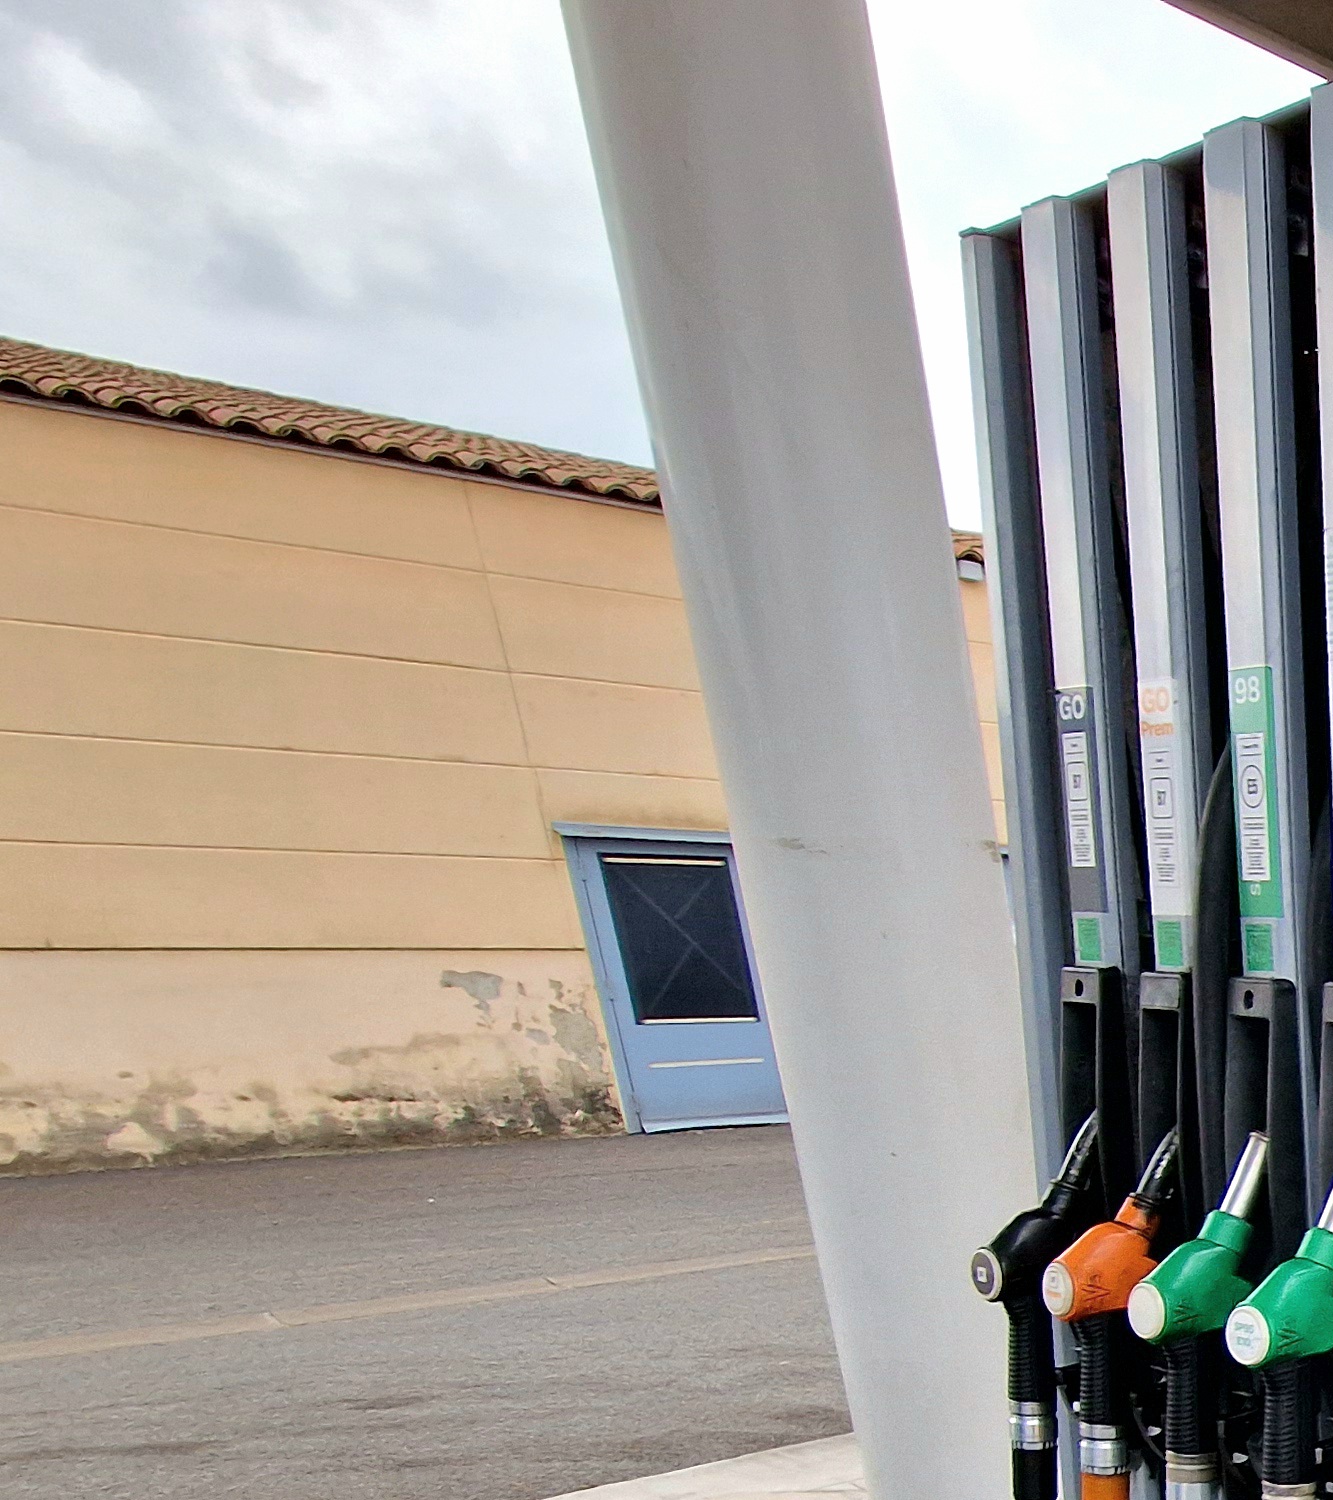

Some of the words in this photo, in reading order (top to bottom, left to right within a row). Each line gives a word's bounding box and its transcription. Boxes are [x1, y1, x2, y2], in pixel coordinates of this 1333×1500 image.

[1141, 687, 1170, 713] GO
[1234, 676, 1261, 704] 98
[1058, 694, 1085, 720] GO
[1140, 721, 1174, 737] Prem
